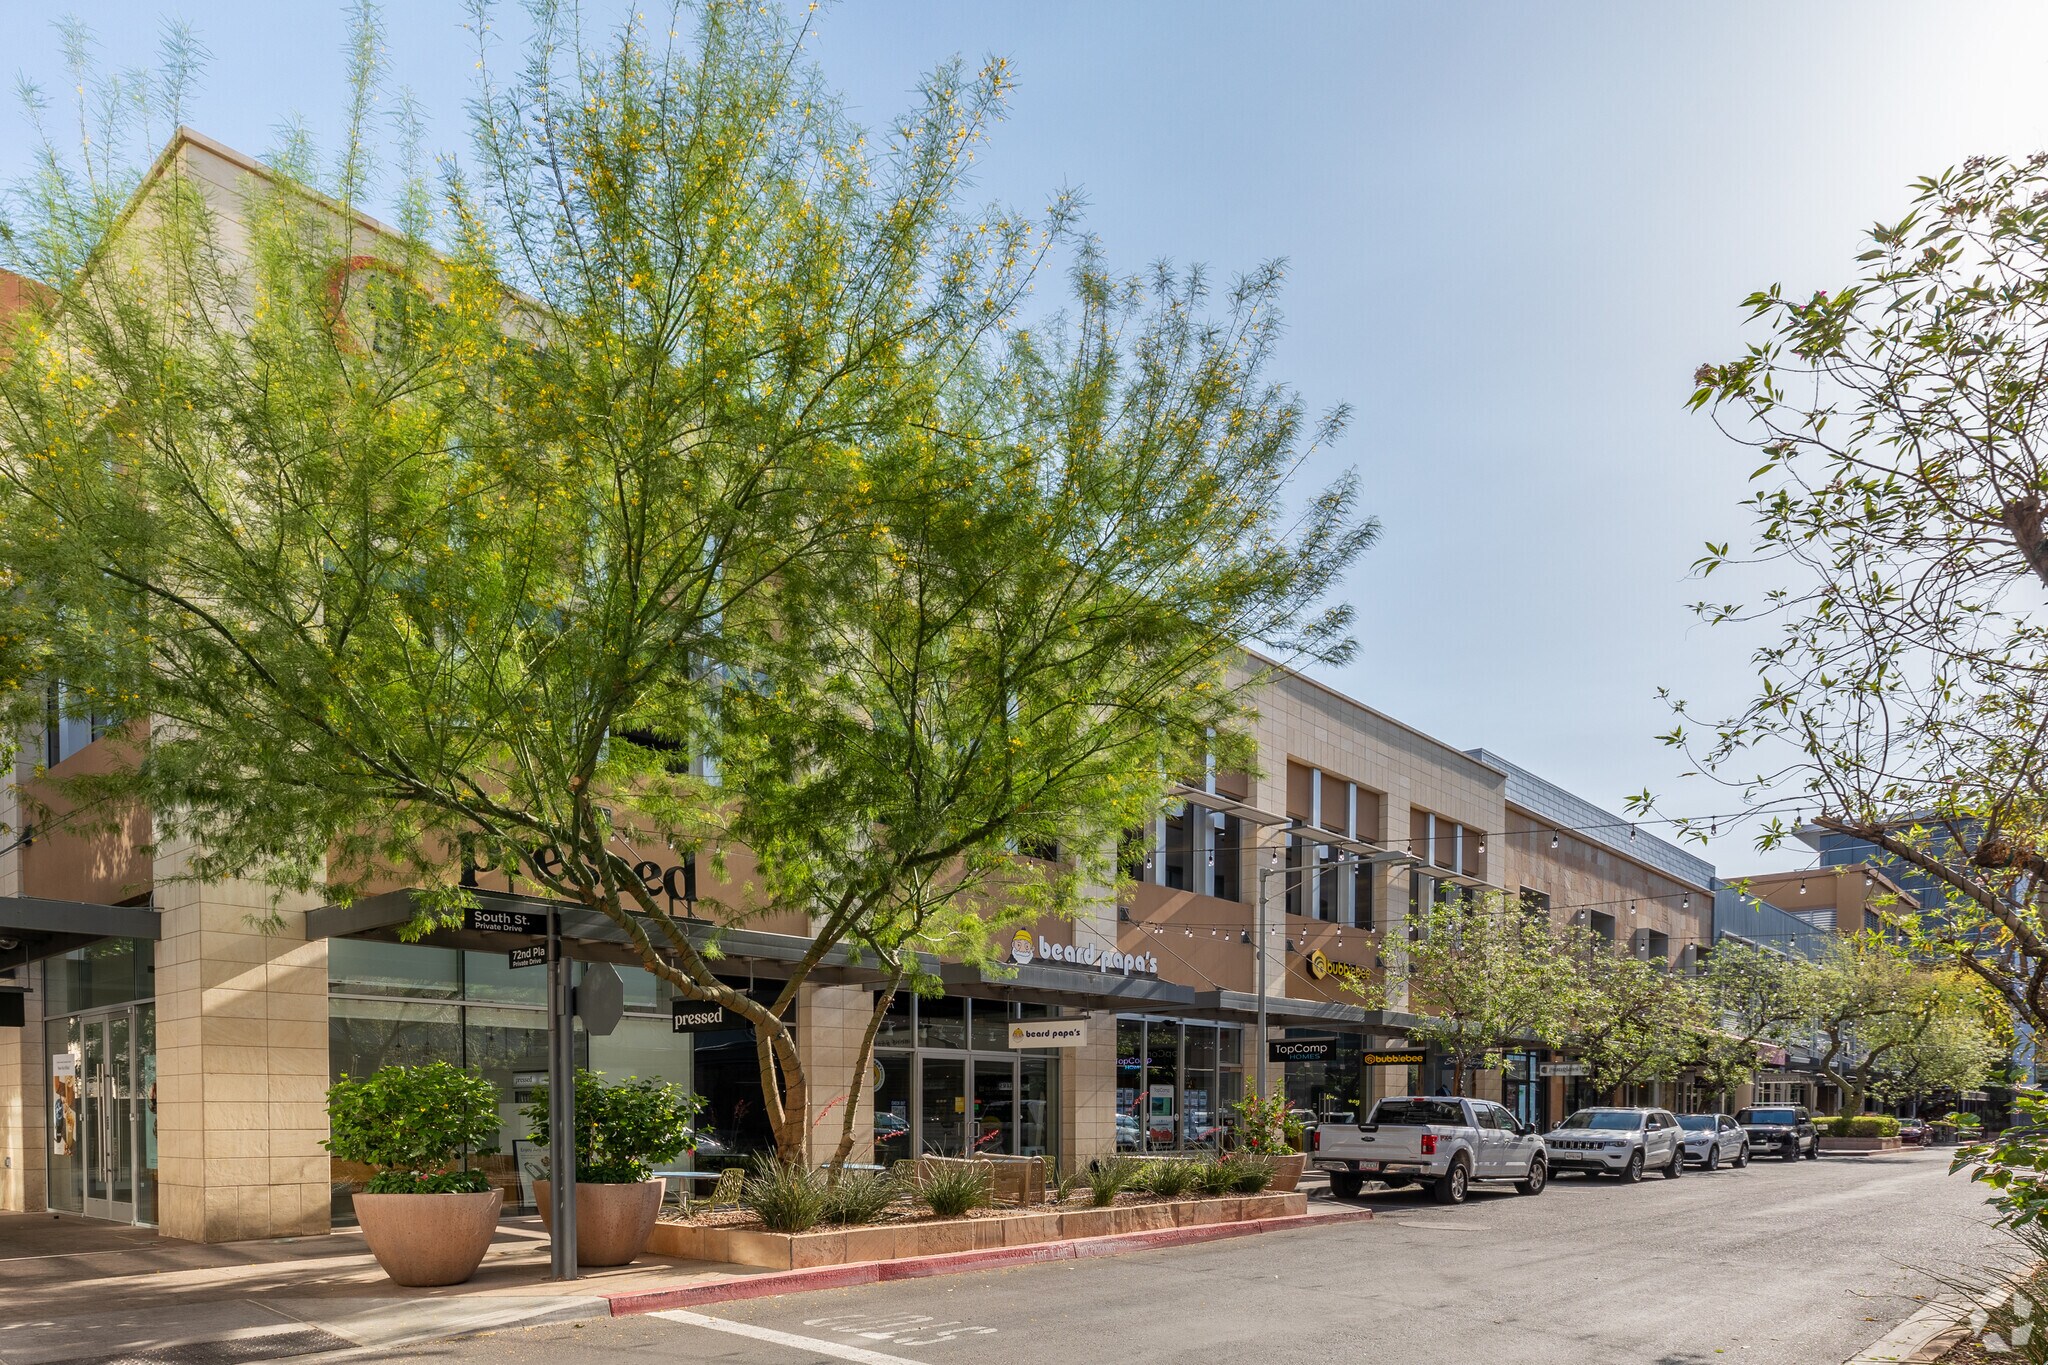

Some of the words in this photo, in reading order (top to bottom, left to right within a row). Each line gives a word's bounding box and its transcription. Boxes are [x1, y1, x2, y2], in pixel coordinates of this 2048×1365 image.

[474, 911, 511, 924] South
[514, 914, 530, 926] St.
[475, 922, 502, 931] Private
[503, 924, 523, 932] Drive
[512, 948, 532, 960] 72nd
[1038, 935, 1095, 966] beard
[1100, 950, 1158, 976] papa's
[512, 960, 529, 968] Private
[529, 958, 542, 966] Drive
[674, 1006, 723, 1030] pressed
[1025, 1029, 1050, 1038] beard
[1052, 1028, 1081, 1039] papa's
[1275, 1043, 1328, 1055] TopComp
[1115, 1056, 1153, 1066] TopCop
[1375, 1054, 1424, 1063] bubblebee
